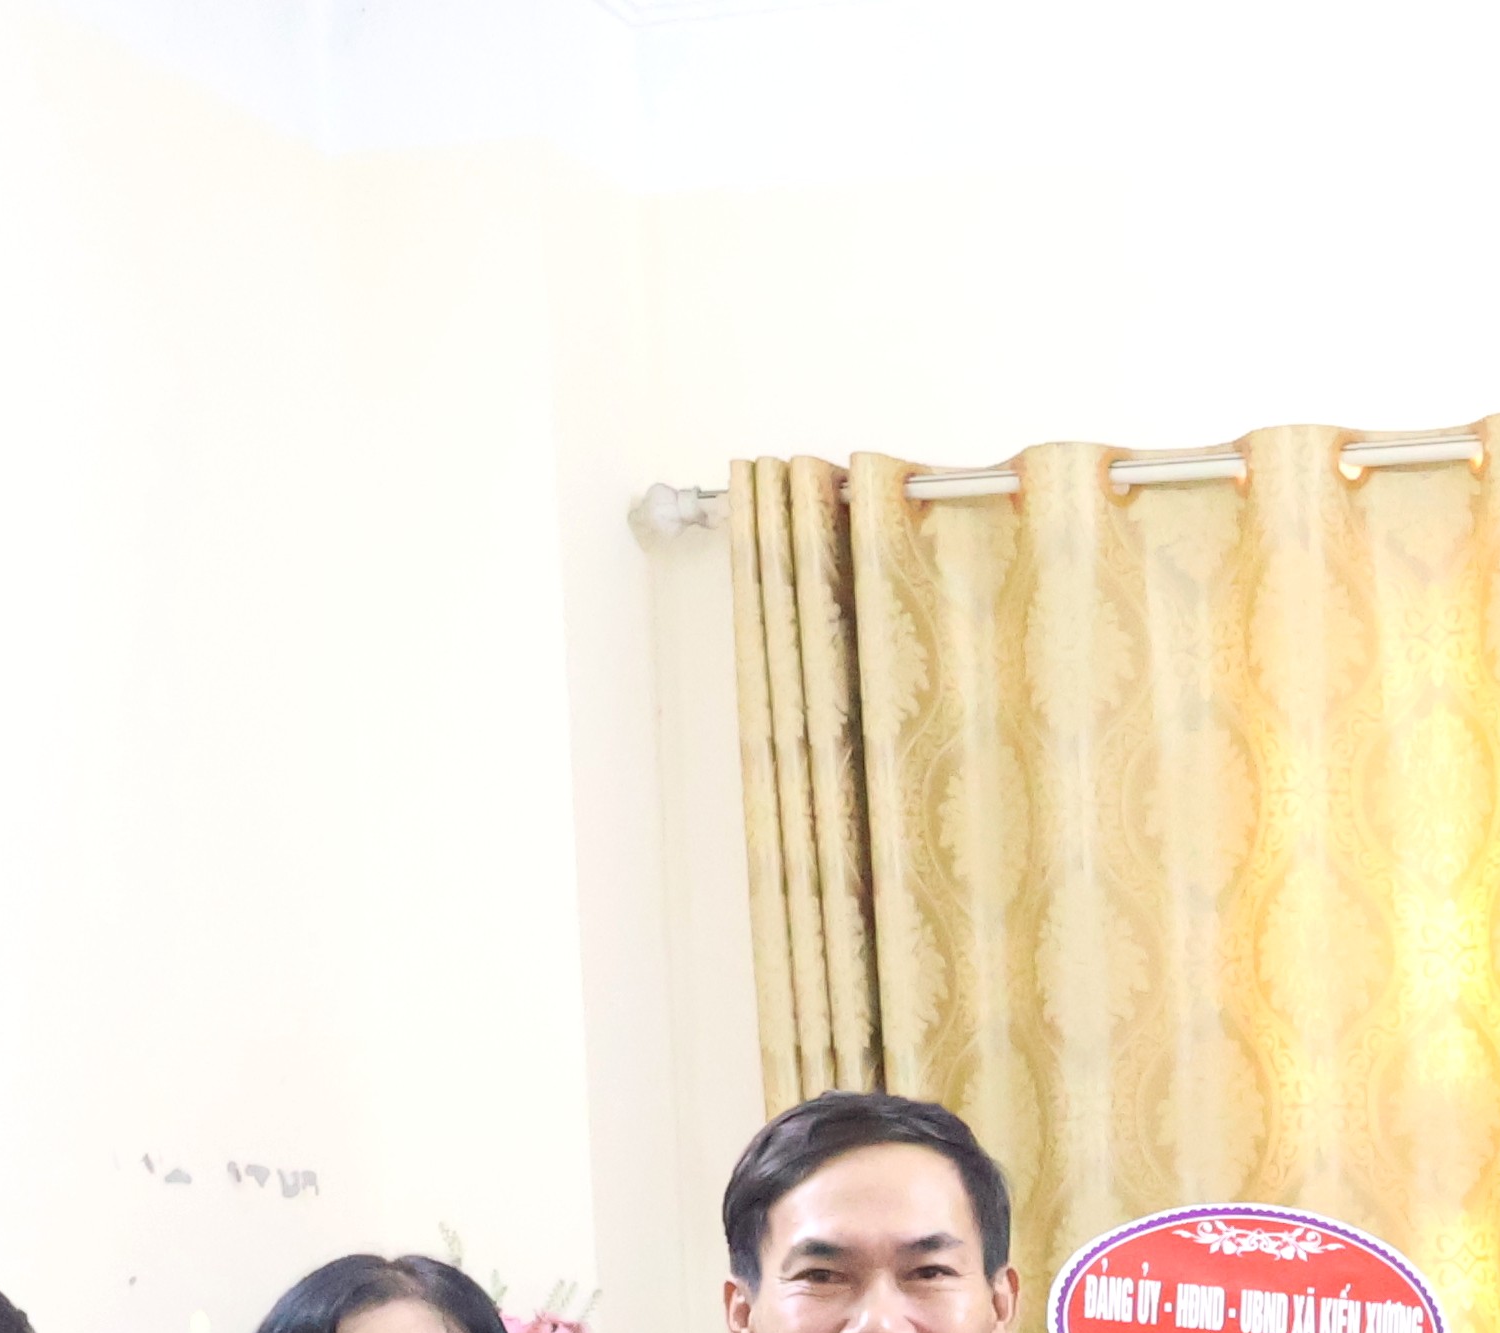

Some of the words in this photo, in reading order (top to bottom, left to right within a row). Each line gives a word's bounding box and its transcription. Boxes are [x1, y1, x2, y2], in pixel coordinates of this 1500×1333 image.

[1084, 1258, 1133, 1323] ĐẢNG
[1137, 1262, 1162, 1325] ỦY
[1175, 1283, 1225, 1331] HĐND
